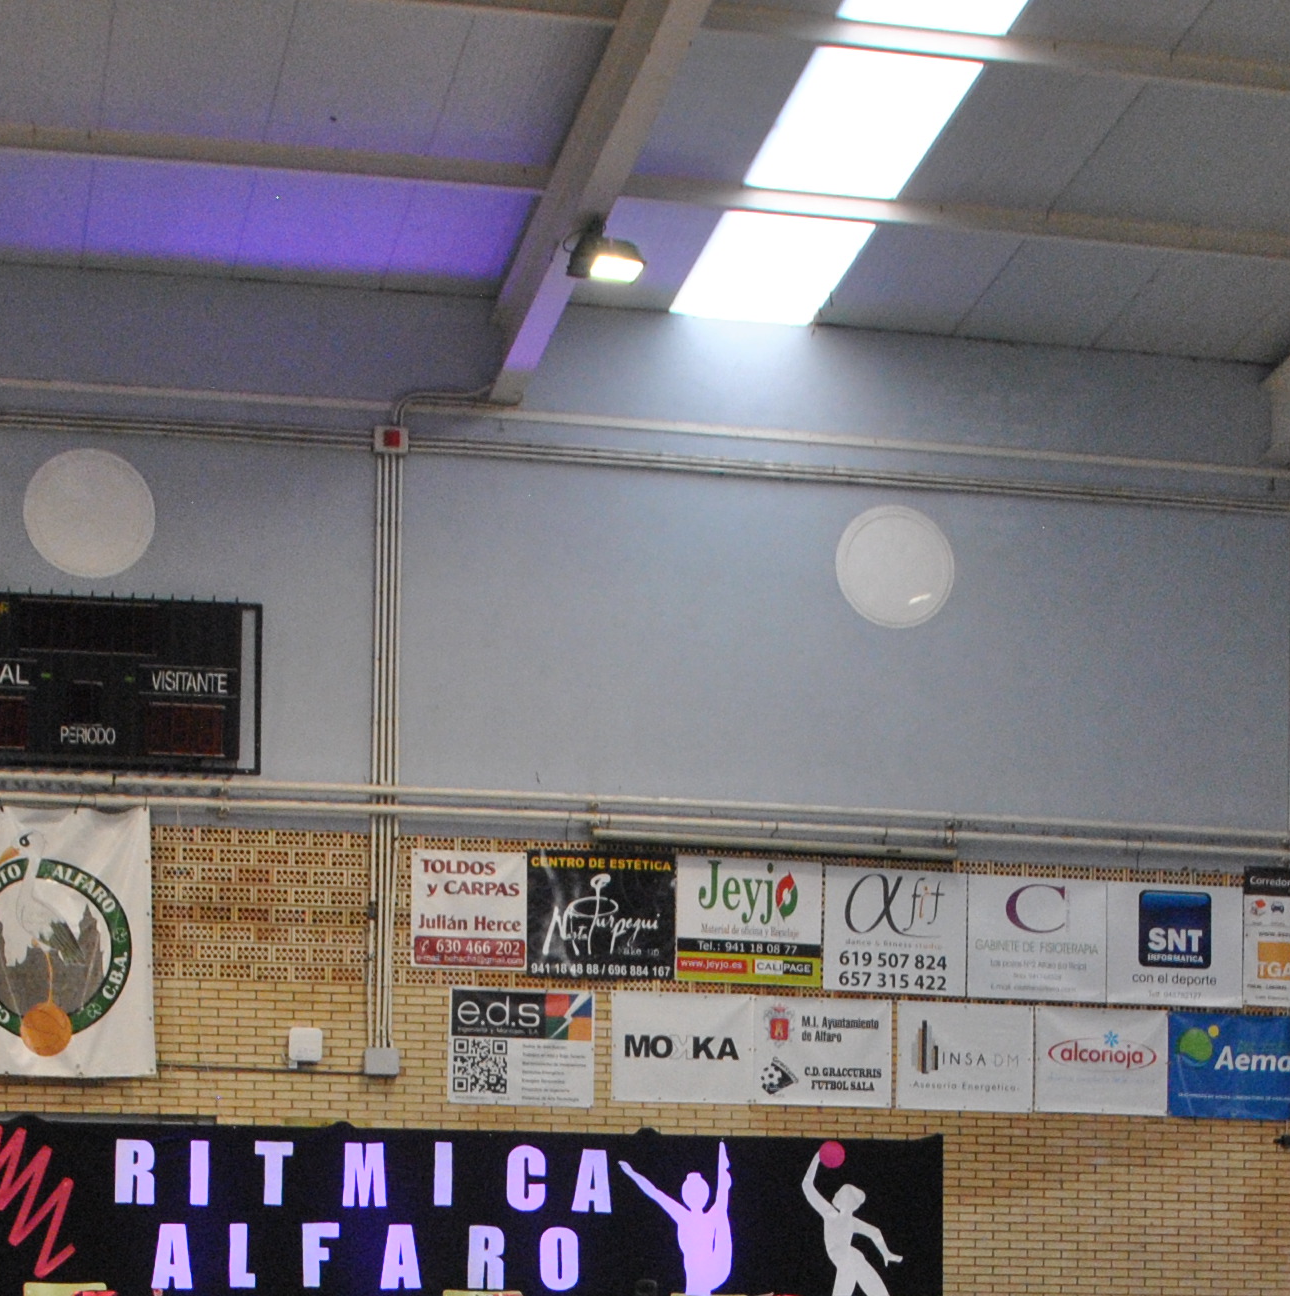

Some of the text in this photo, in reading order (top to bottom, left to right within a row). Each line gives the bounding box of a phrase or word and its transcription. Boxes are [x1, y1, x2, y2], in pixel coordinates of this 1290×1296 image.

[151, 670, 228, 694] VISITANTE
[60, 725, 116, 745] PERIODO
[420, 858, 496, 876] TOLDOS
[531, 857, 672, 871] CENTRO DE ESTÉTICA
[52, 864, 116, 913] ALFARO
[426, 880, 520, 897] y CARPAS
[1249, 875, 1290, 887] Corredor
[418, 913, 521, 932] Julián Herce
[436, 940, 520, 955] 630 466 202
[975, 939, 1020, 953] GABINETE
[1147, 927, 1203, 953] SNT
[725, 942, 745, 952] 941
[750, 943, 763, 953] 18
[766, 943, 781, 954] 08
[784, 945, 797, 955] 77
[680, 960, 743, 970] www.jeyjo.es
[839, 950, 947, 971] 619 507 824
[531, 963, 550, 974] 941
[555, 963, 567, 974] 18
[652, 966, 671, 977] 167
[838, 971, 947, 991] 657 315 422
[1132, 973, 1217, 987] con el deporte
[457, 995, 541, 1027] e.d.s
[801, 1015, 879, 1030] M.I. Ayuntamiento
[801, 1030, 842, 1043] de Alfaro
[942, 1051, 987, 1067] INSA
[804, 1066, 882, 1078] C.D. GRACCURRIS
[850, 1081, 875, 1091] SALA
[151, 1222, 579, 1291] ALFARO
